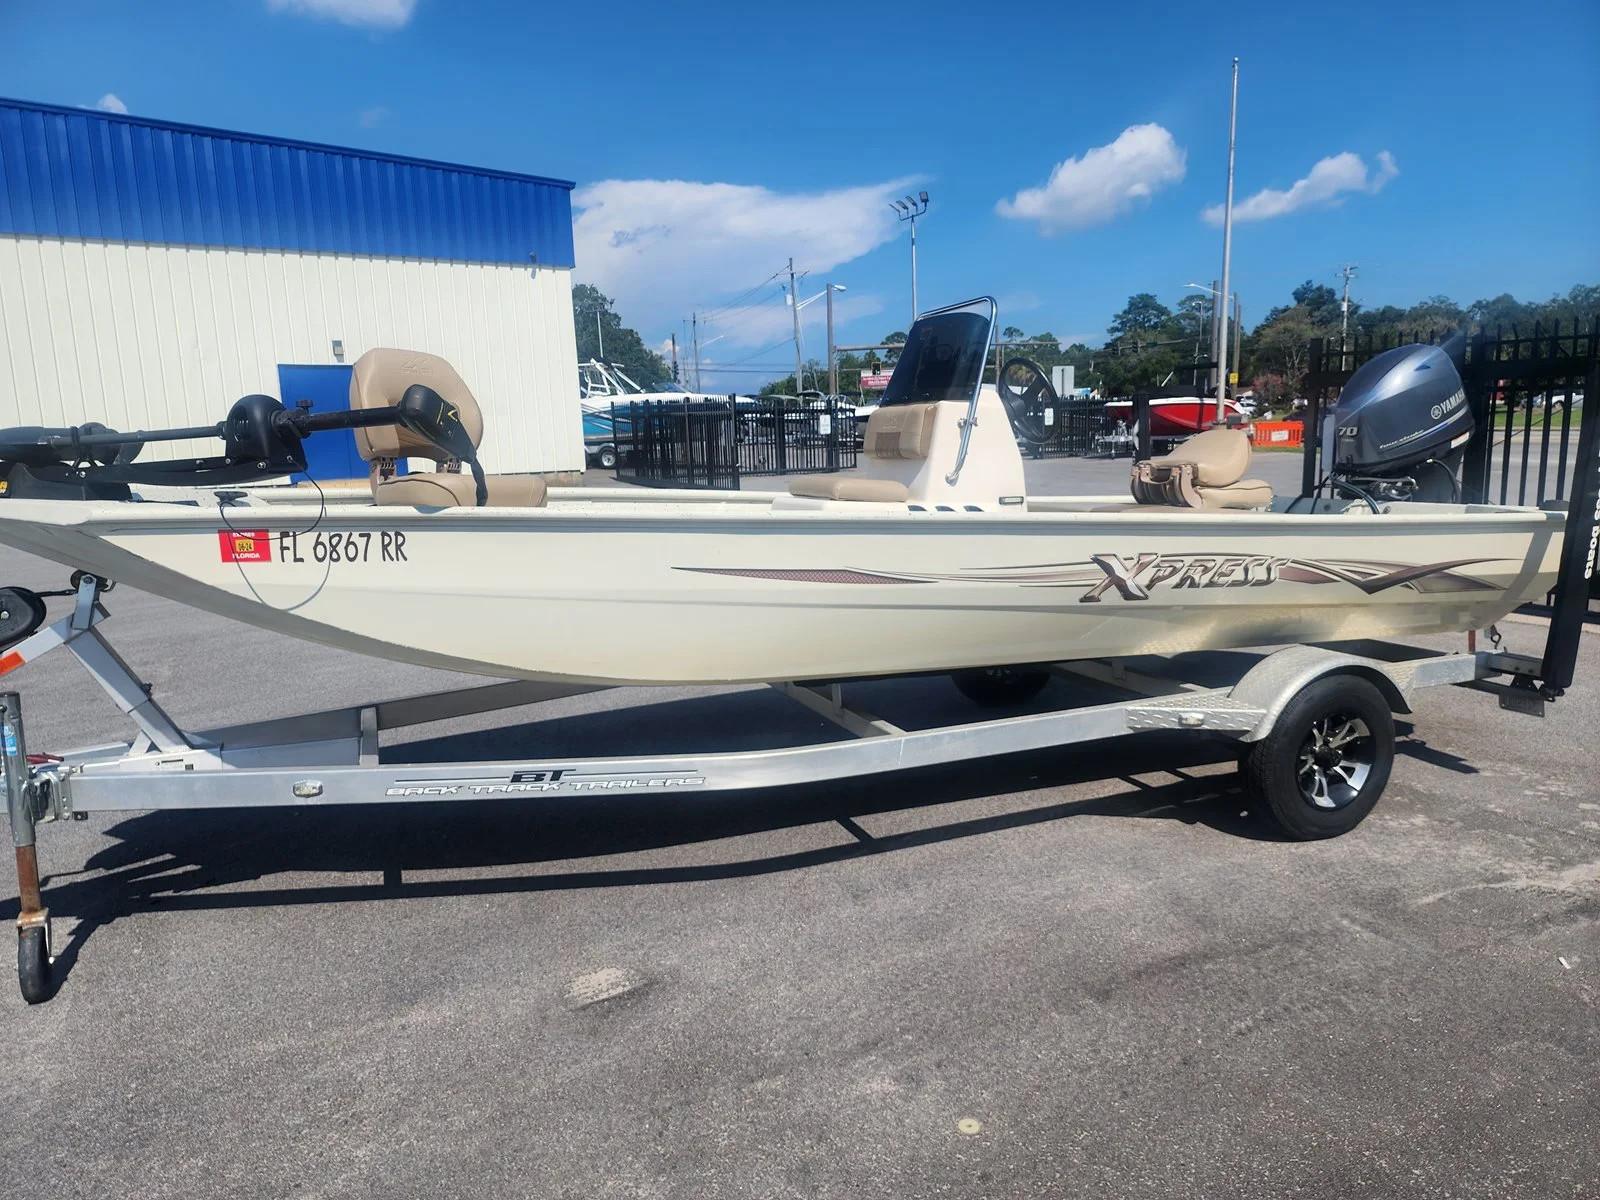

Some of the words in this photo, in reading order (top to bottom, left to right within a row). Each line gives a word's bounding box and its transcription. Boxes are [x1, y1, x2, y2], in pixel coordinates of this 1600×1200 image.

[1338, 427, 1358, 436] 70
[280, 531, 305, 563] FL
[312, 531, 372, 563] 6867
[381, 531, 408, 562] RR
[232, 552, 261, 560] FLORIDA
[1079, 552, 1291, 602] XPRESS
[510, 769, 577, 783] BT
[384, 785, 462, 796] BACK
[468, 781, 565, 794] TRACK
[570, 776, 706, 790] TRAILERS
